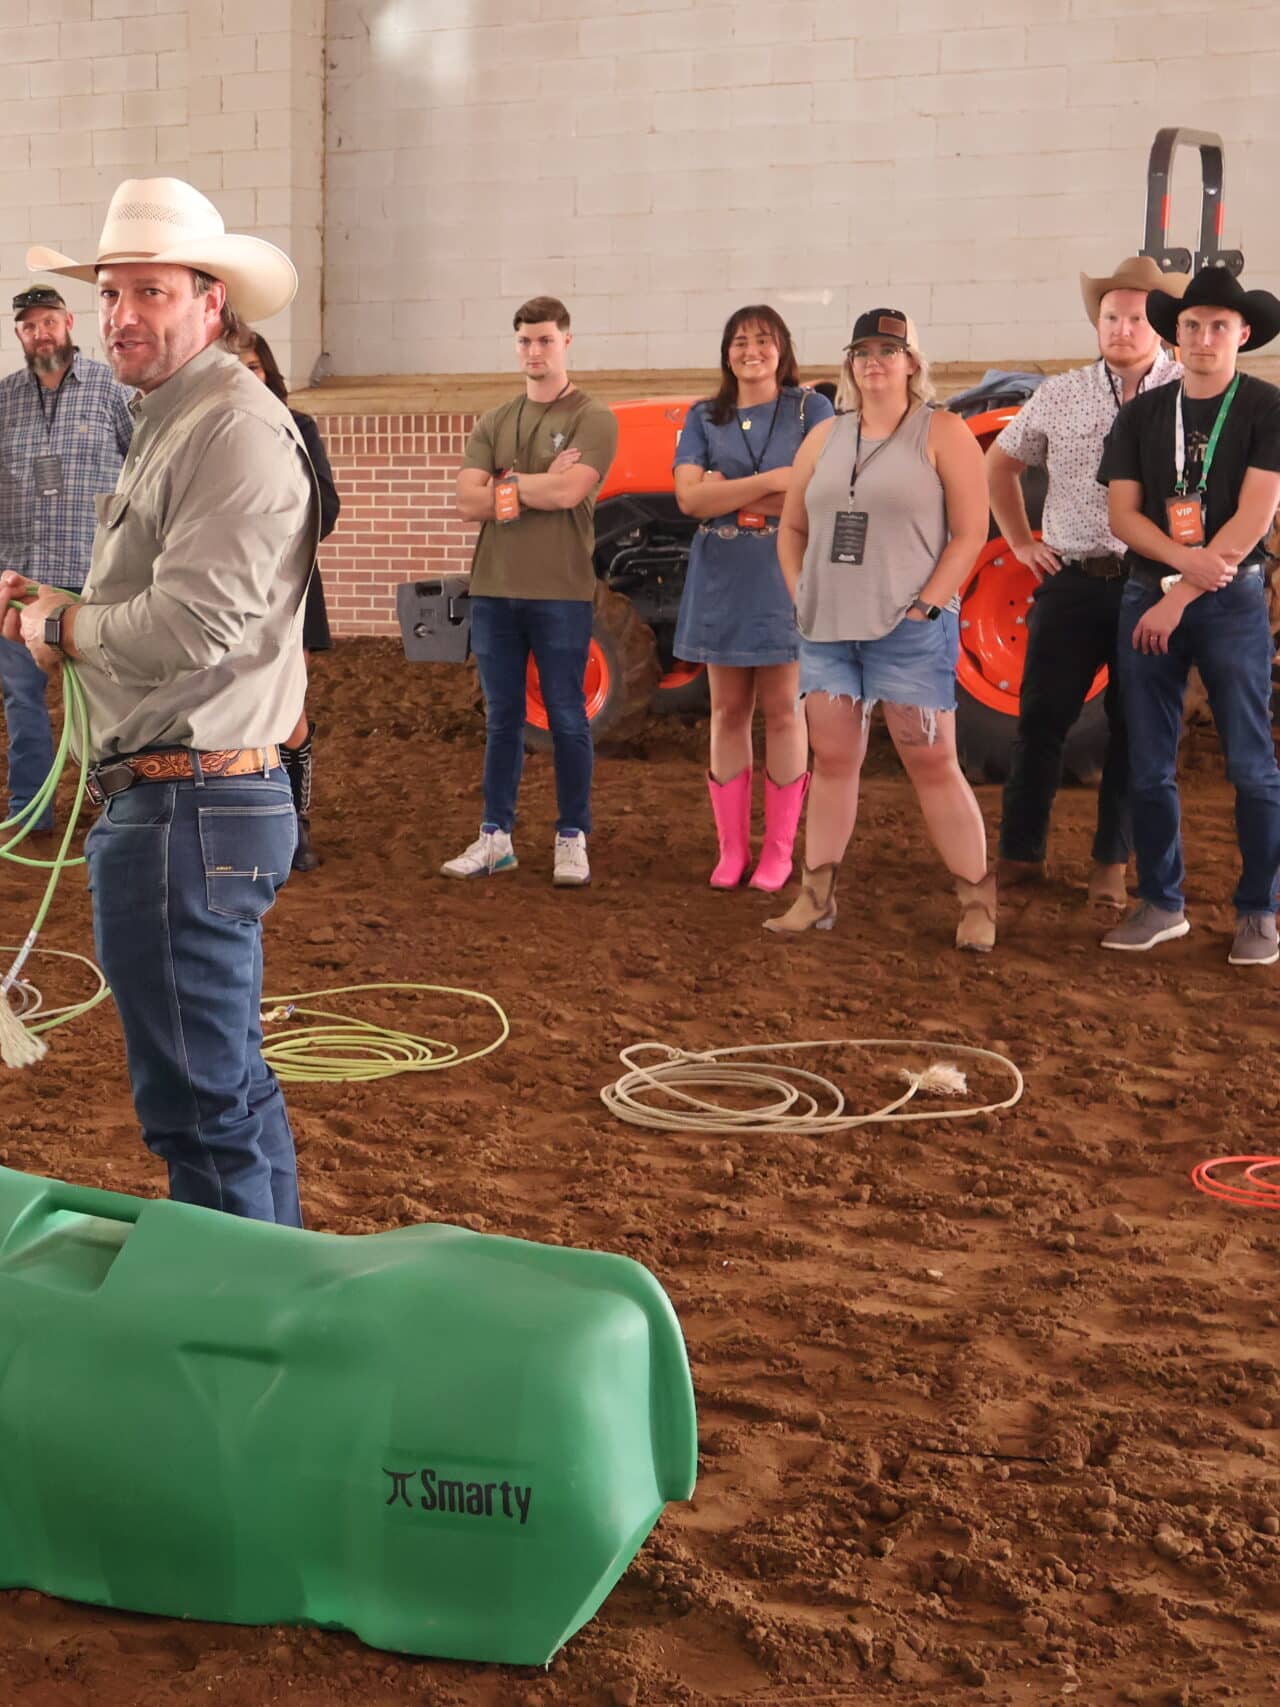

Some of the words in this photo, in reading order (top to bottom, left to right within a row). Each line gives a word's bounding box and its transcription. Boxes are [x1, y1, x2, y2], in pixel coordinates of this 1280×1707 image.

[499, 487, 513, 496] VIP
[1175, 507, 1193, 517] VIP
[421, 1469, 532, 1524] Smarty
